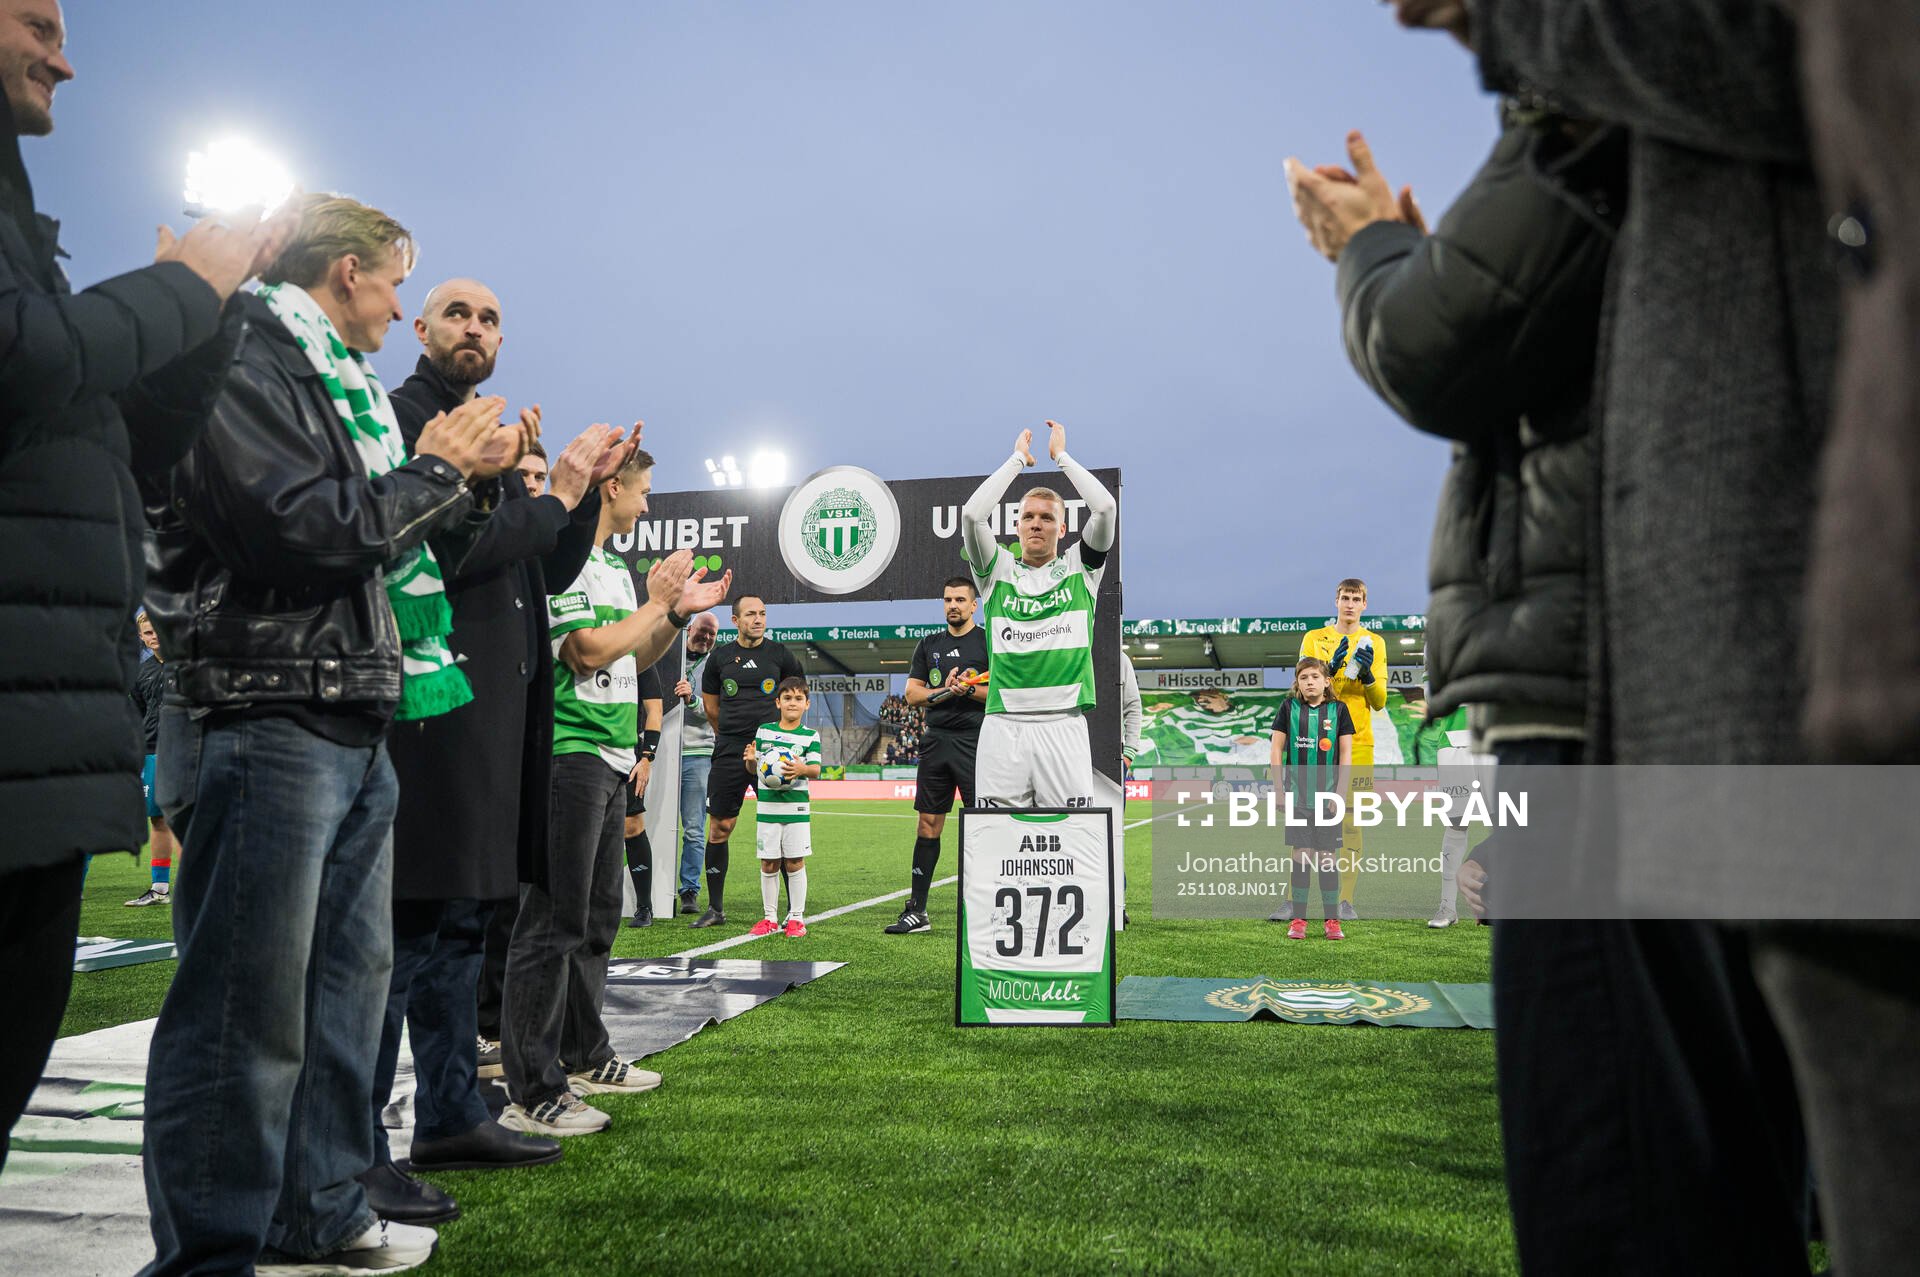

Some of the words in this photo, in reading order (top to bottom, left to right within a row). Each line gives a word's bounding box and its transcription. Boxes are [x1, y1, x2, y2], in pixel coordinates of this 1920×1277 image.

[826, 509, 853, 518] VSK
[612, 516, 749, 553] UNIBET
[551, 594, 587, 608] UNIBET
[1002, 588, 1073, 614] HITACHI
[1264, 620, 1307, 632] Telexia
[775, 629, 813, 641] Telexia
[841, 628, 880, 639] Telexia
[1167, 672, 1227, 687] Hisstech
[1236, 672, 1258, 686] AB
[1390, 670, 1413, 684] AB
[864, 679, 885, 692] AB
[1019, 835, 1062, 852] ABB
[1000, 858, 1074, 877] JOHANSSON
[995, 885, 1084, 957] 372
